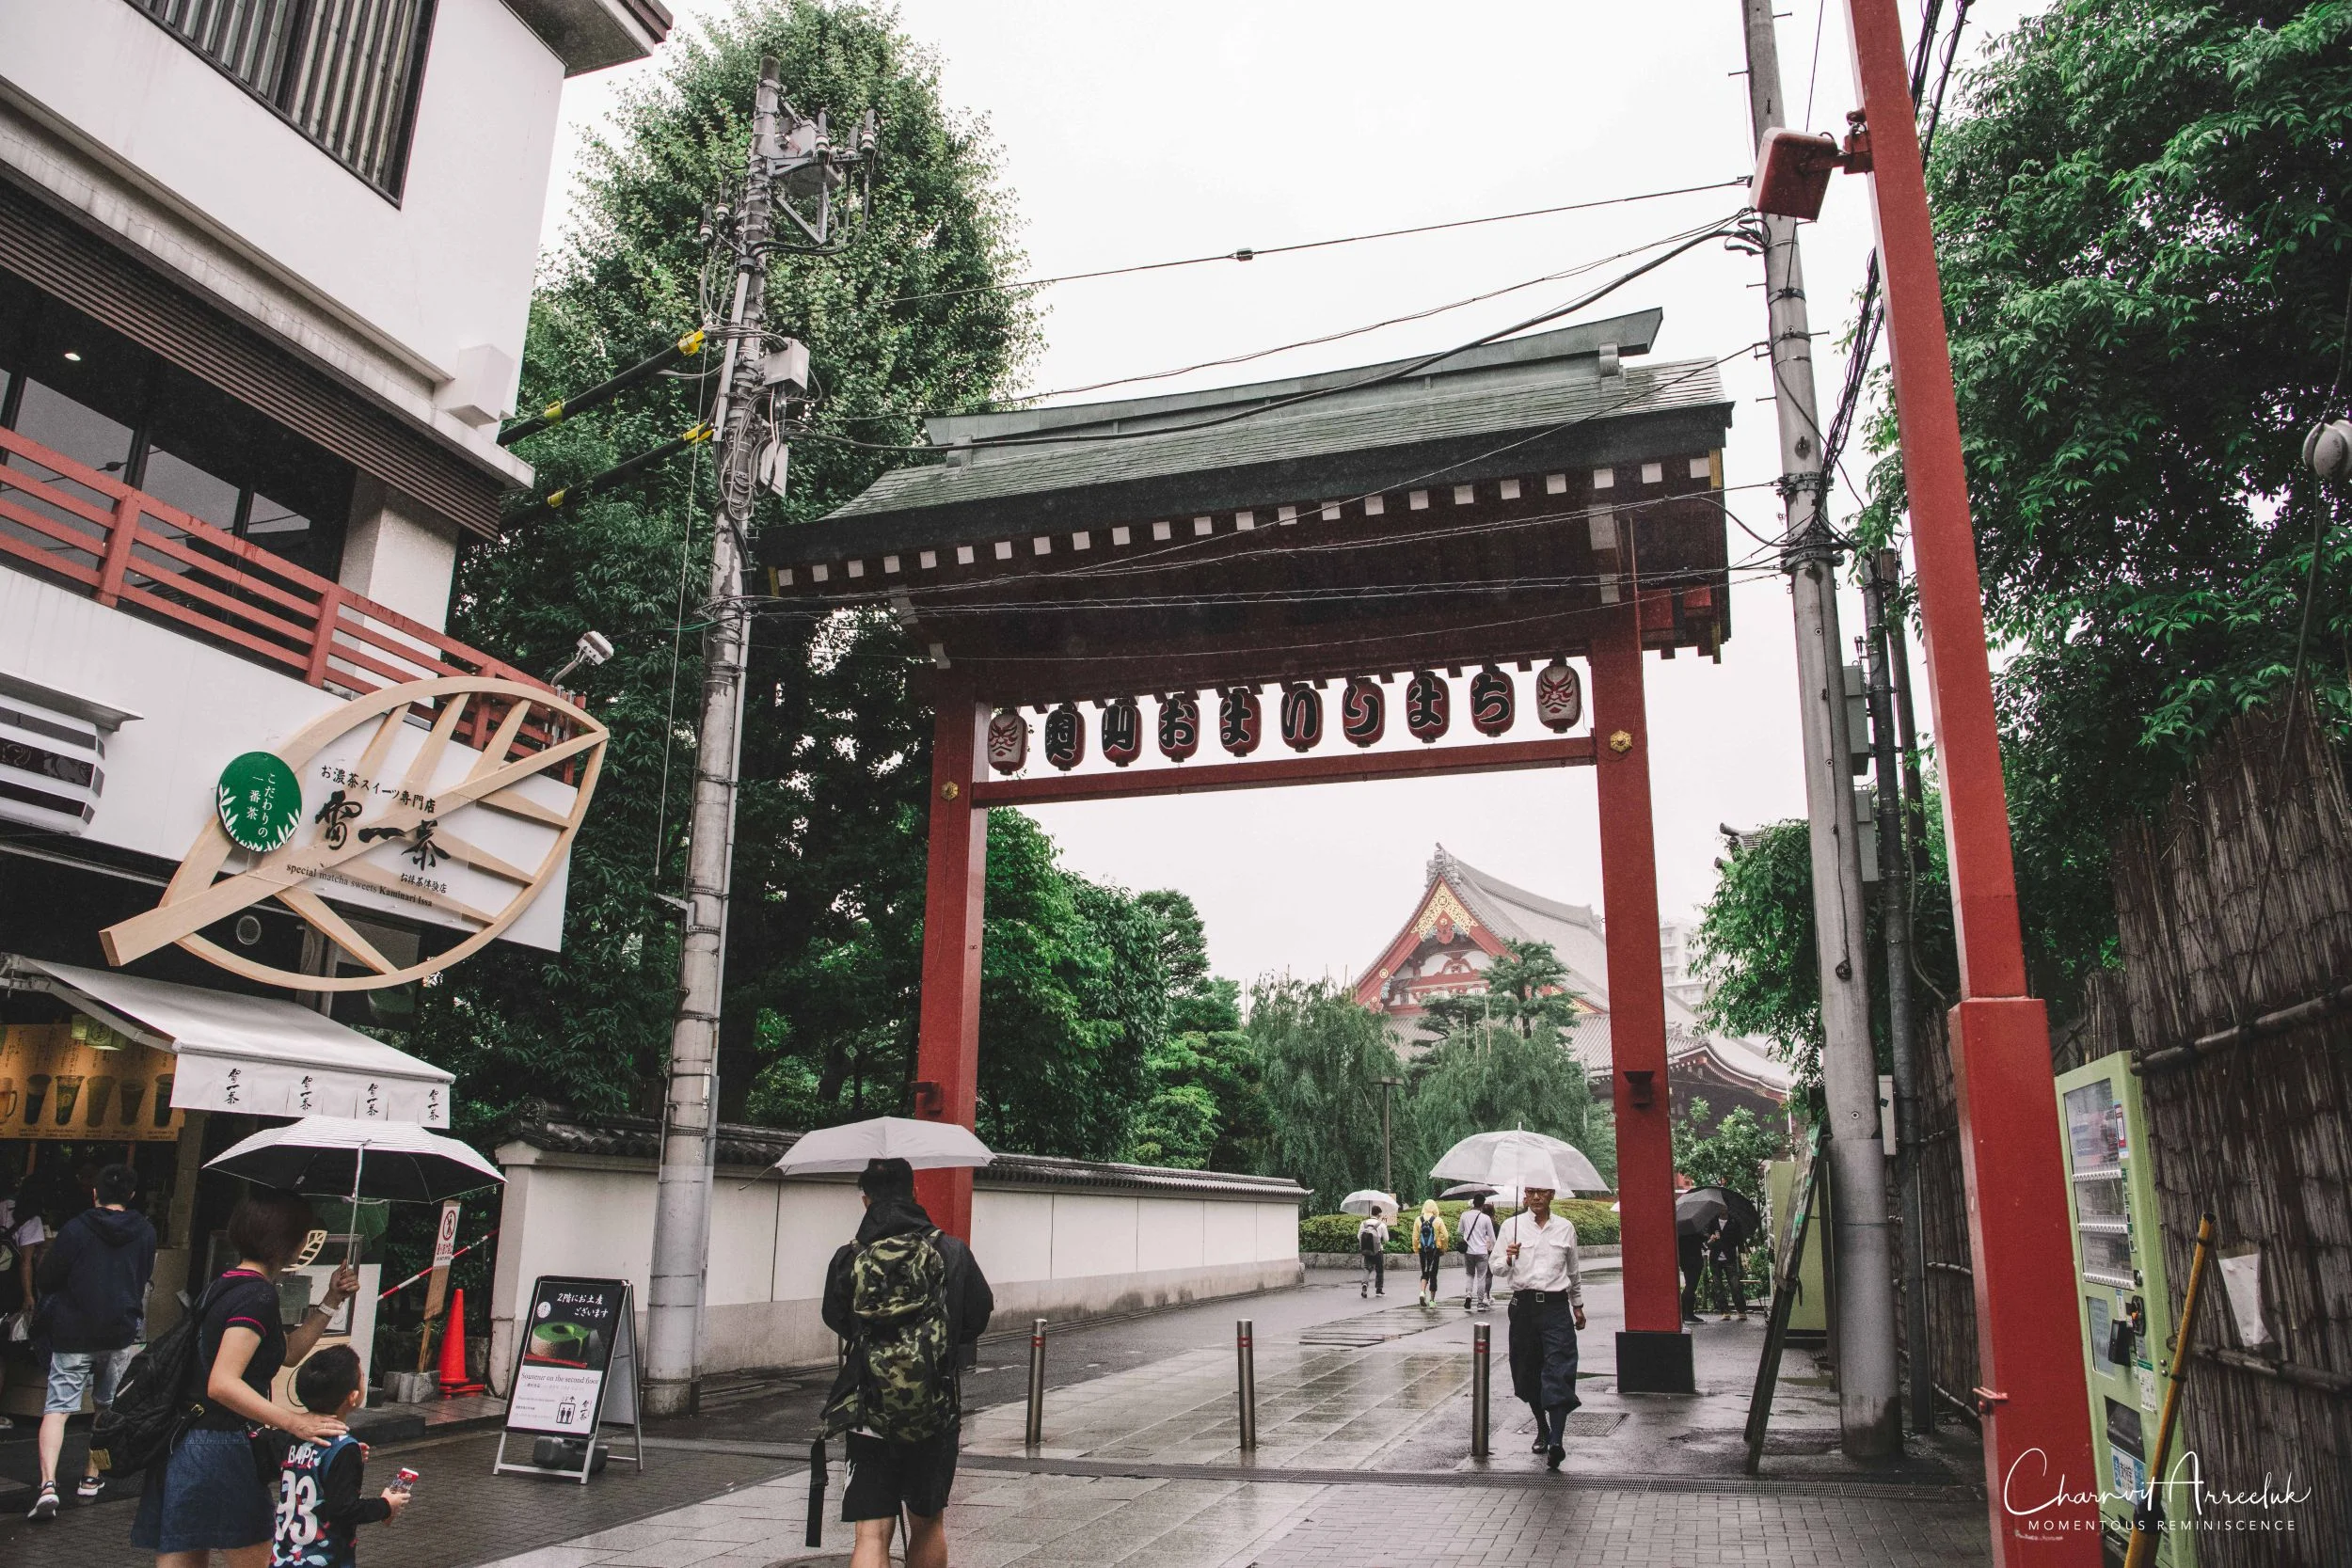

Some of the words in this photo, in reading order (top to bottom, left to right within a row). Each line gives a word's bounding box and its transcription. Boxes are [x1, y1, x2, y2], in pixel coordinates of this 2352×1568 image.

[246, 776, 263, 820] 一番茶
[258, 773, 276, 837] こだわりの
[321, 765, 436, 815] お濃茶スイーツ専門店
[286, 863, 317, 879] special
[319, 872, 349, 886] matcha
[350, 880, 377, 894] sweets
[379, 885, 417, 904] Kaminari
[418, 895, 433, 907] Issa
[400, 872, 448, 894] お抹茶体験店
[557, 1292, 603, 1305] 2階にお土産
[574, 1307, 609, 1318] ございます
